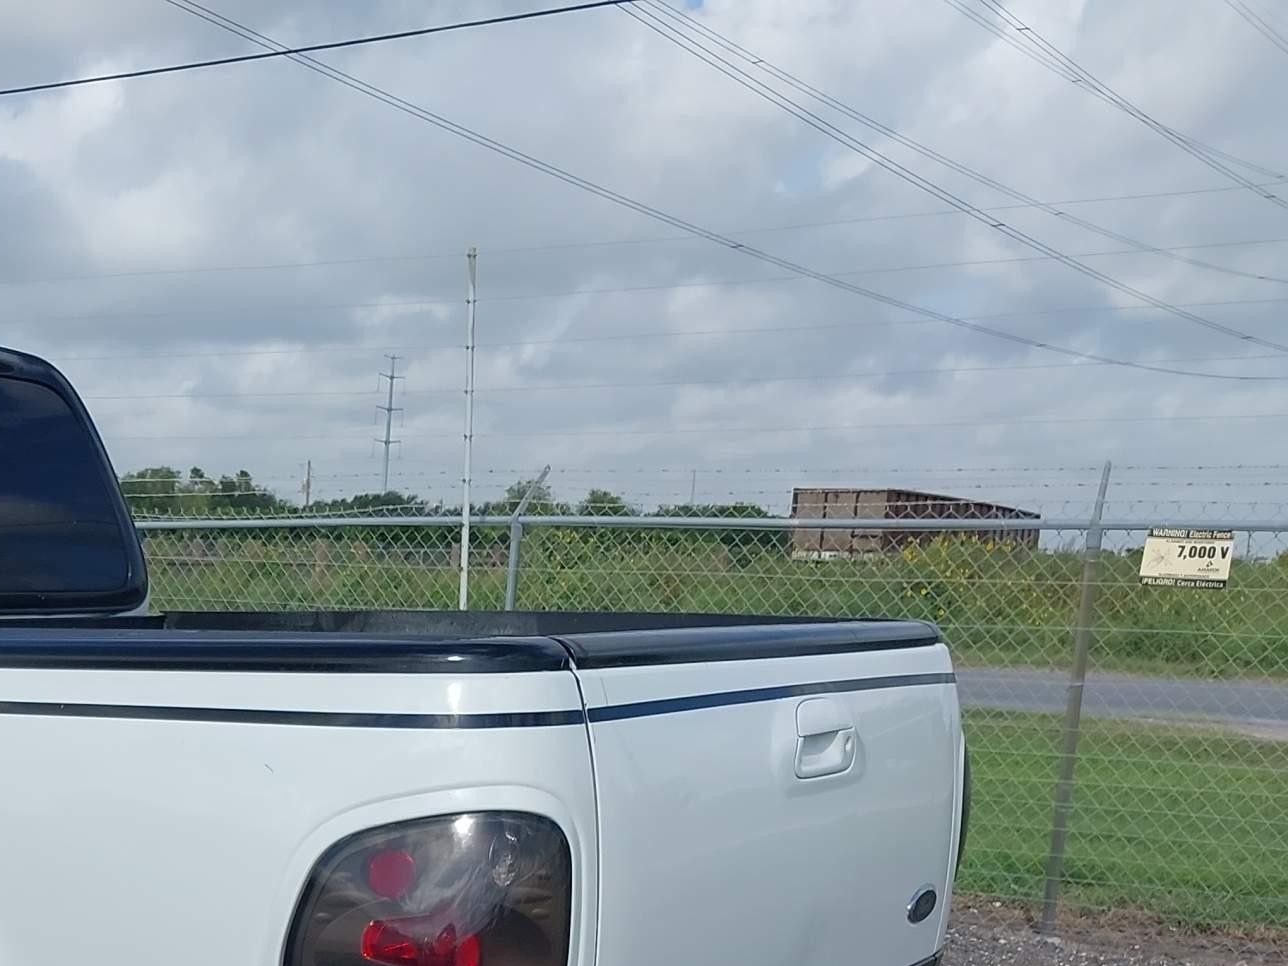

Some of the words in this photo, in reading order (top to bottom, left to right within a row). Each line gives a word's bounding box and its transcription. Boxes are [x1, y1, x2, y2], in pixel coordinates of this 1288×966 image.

[1152, 527, 1188, 538] WARNING!
[1189, 528, 1212, 539] Electric
[1213, 530, 1231, 540] Fence
[1177, 545, 1217, 560] 7,000
[1221, 546, 1230, 559] V
[1177, 578, 1195, 588] Cerca
